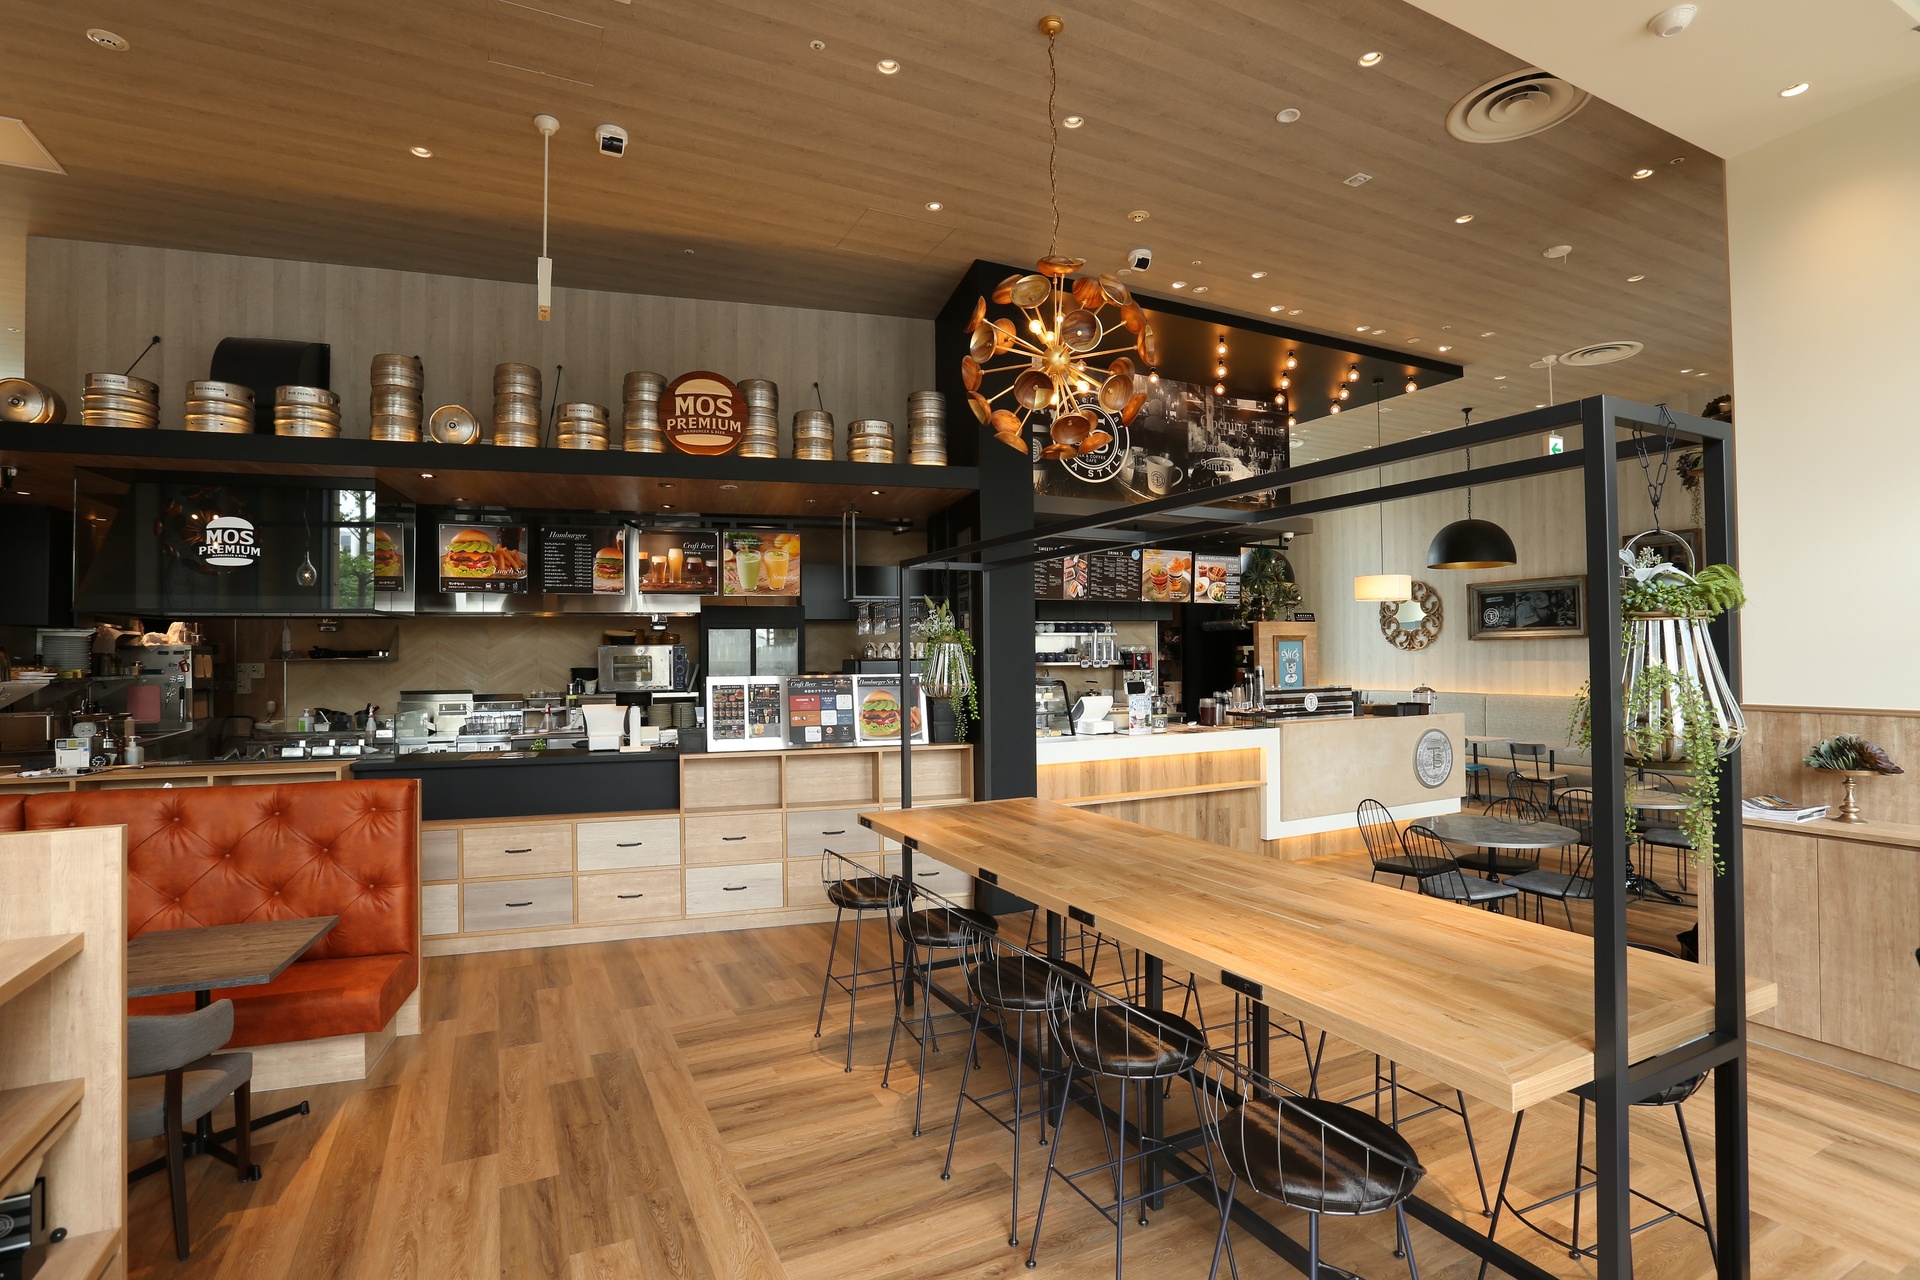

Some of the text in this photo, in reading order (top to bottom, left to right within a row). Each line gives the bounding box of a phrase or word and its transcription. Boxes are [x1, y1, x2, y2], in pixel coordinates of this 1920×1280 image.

[675, 395, 733, 417] MOS
[666, 417, 742, 433] PREMIUM
[1252, 420, 1286, 437] Times
[1088, 448, 1125, 477] STYLE
[206, 529, 254, 545] MOS
[549, 531, 587, 540] Hamburger
[199, 544, 261, 557] PREMIUM
[683, 541, 700, 550] Craft
[790, 680, 804, 688] Craft
